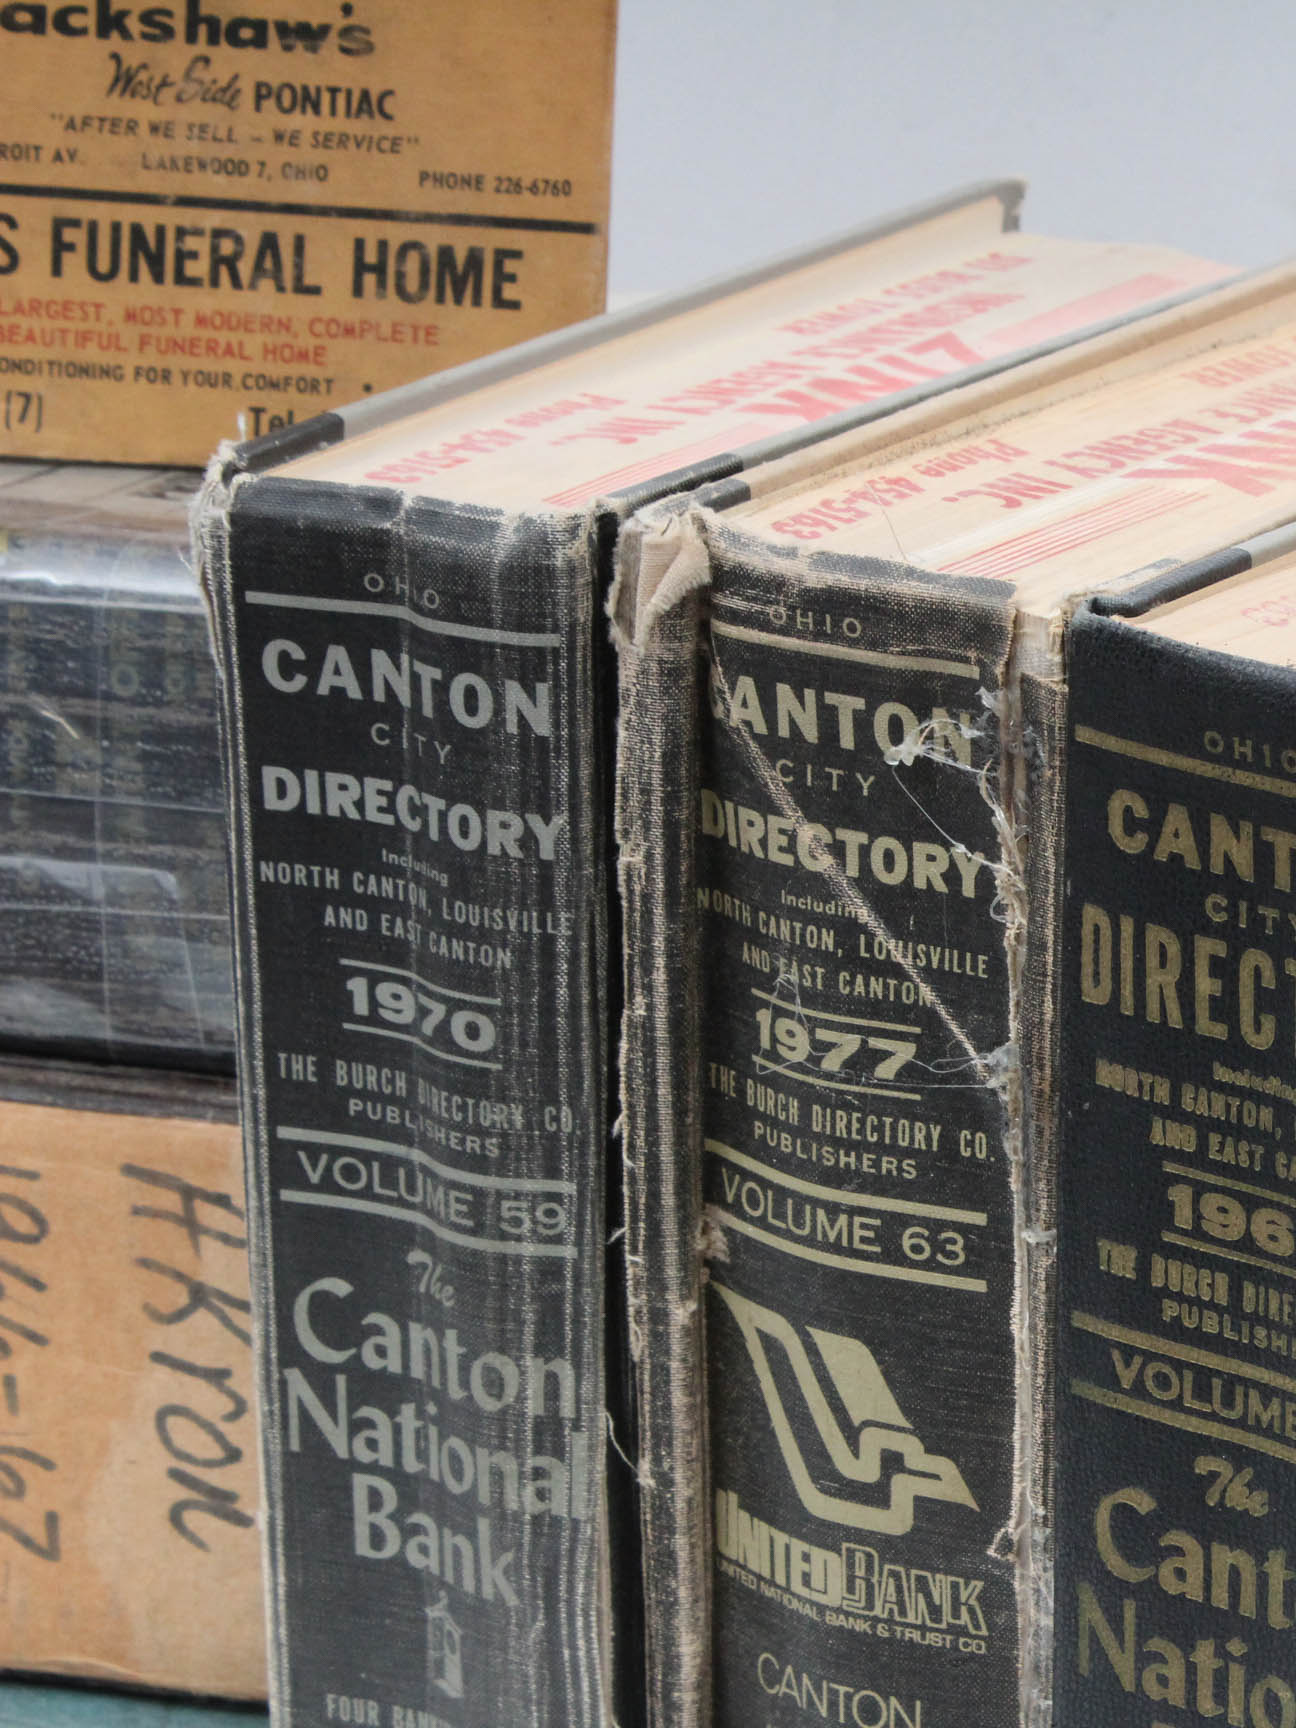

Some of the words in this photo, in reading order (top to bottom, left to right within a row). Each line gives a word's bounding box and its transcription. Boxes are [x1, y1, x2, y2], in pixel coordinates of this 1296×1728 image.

[107, 52, 175, 105] West
[176, 54, 242, 111] Side
[254, 82, 395, 121] PONTIAC
[142, 152, 249, 177] LAKEWOOD
[149, 120, 175, 138] WE
[272, 129, 300, 148] WE
[419, 171, 485, 192] PHONE
[494, 175, 572, 198] 226-6760
[51, 216, 322, 296] FUNERAL
[353, 236, 523, 311] HOME
[124, 304, 185, 328] MOST
[193, 311, 299, 339] MODERN,
[308, 316, 440, 347] COMPLETE
[139, 333, 252, 361] FUNERAL
[262, 341, 328, 367] HOME
[134, 366, 172, 386] FOR
[181, 369, 232, 390] YOUR
[241, 371, 335, 397] COMFORT
[740, 327, 987, 425] ZINK
[911, 437, 1031, 481] Phone
[1062, 415, 1225, 480] AGENCY
[770, 474, 924, 541] 454-5163
[941, 467, 1074, 510] INC.
[363, 573, 440, 609] OHIO
[770, 606, 863, 639] OHIO
[261, 638, 552, 737] CANTON
[370, 723, 452, 765] CITY
[775, 759, 876, 798] CITY
[261, 765, 566, 860] DIRECTORY
[701, 788, 986, 899] DIRECTORY
[259, 860, 340, 891] NORTH
[352, 871, 433, 916] CANTON,
[442, 897, 573, 936] LOUISVILLE
[381, 848, 449, 887] Including
[324, 905, 368, 931] AND
[380, 914, 424, 945] EAST
[429, 931, 513, 969] CANTON
[697, 887, 751, 928] NORTH
[759, 911, 843, 958] CANTON,
[860, 934, 989, 979] LOUISVILLE
[781, 889, 868, 924] Including
[742, 942, 771, 973] AND
[779, 953, 826, 991] EAST
[838, 971, 933, 1008] CANTON
[346, 976, 496, 1053] 1970
[755, 1007, 918, 1081] 1977
[277, 1053, 317, 1082] THE
[336, 1060, 407, 1098] BURCH
[417, 1078, 524, 1131] DIRECTORY
[544, 1106, 581, 1135] CO.
[710, 1062, 737, 1098] THE
[746, 1078, 801, 1126] BURCH
[811, 1104, 942, 1152] DIRECTORY
[960, 1129, 996, 1163] CO.
[1095, 1057, 1171, 1106] NORTH
[1182, 1084, 1283, 1141] CANTON,
[348, 1098, 502, 1158] PUBLISHERS
[753, 1120, 919, 1180] PUBLISHERS
[1149, 1116, 1197, 1152] AND
[1208, 1132, 1265, 1172] EAST
[298, 1150, 474, 1228] VOLUME
[500, 1201, 567, 1236] 59
[721, 1167, 882, 1253] VOLUME
[902, 1226, 967, 1266] 63
[407, 1250, 456, 1308] The
[1097, 1237, 1138, 1280] THE
[1151, 1253, 1229, 1306] BURCH
[293, 1277, 577, 1419] Canton
[283, 1367, 591, 1520] National
[352, 1472, 518, 1606] Bank
[760, 1580, 822, 1623] NATIONAL
[825, 1612, 873, 1642] BANK
[877, 1624, 890, 1638] &
[894, 1625, 952, 1649] TRUST
[327, 1693, 379, 1728] FOUR
[757, 1652, 922, 1728] CANTON
